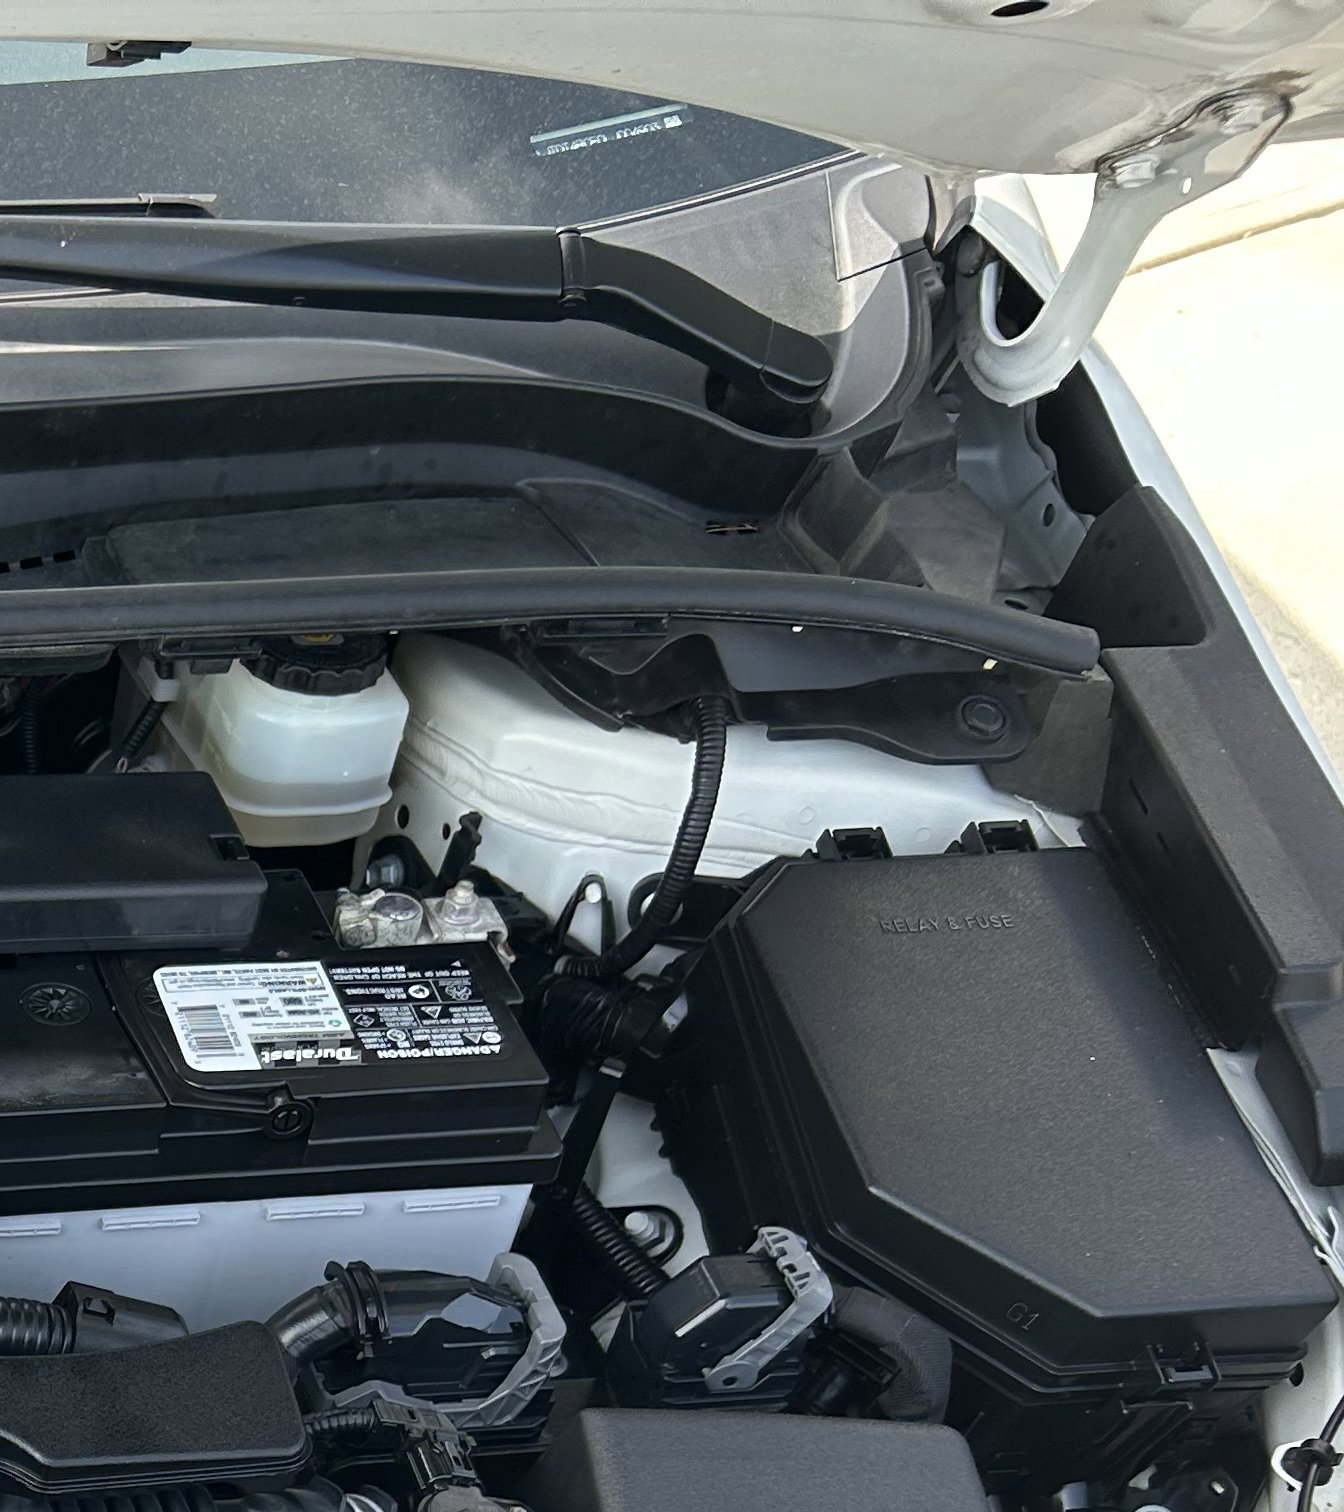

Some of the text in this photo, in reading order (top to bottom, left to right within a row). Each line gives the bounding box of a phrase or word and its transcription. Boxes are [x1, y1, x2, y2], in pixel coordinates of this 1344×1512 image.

[880, 914, 1014, 933] RELAY & FUSE
[257, 1046, 359, 1063] Duralast
